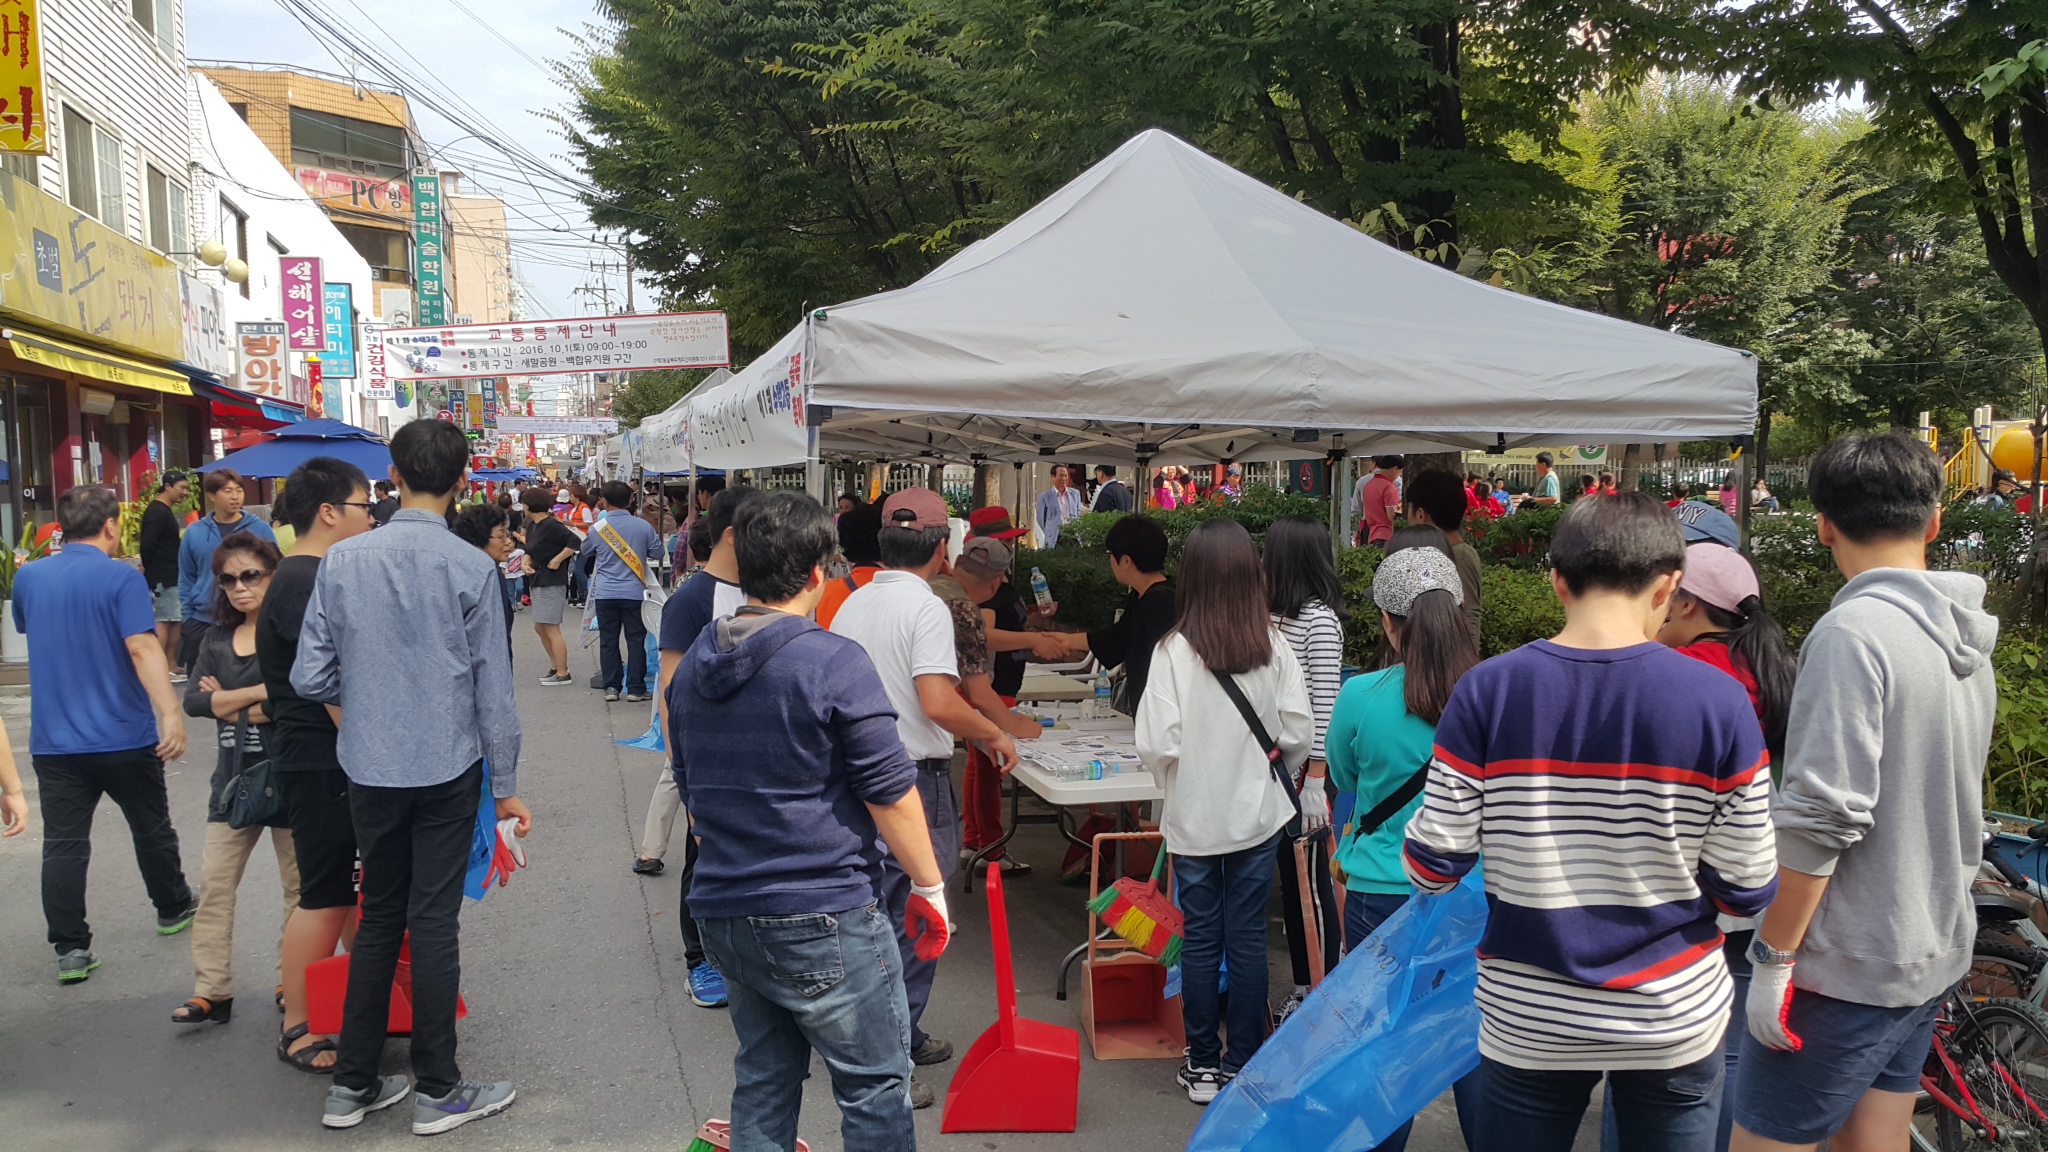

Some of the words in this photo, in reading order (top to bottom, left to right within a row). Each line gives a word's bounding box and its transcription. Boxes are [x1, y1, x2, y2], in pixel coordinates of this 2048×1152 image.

[418, 181, 440, 295] 백합미술학원
[241, 325, 276, 333] 현대
[325, 306, 344, 355] 애터미
[366, 344, 387, 389] 건강식품
